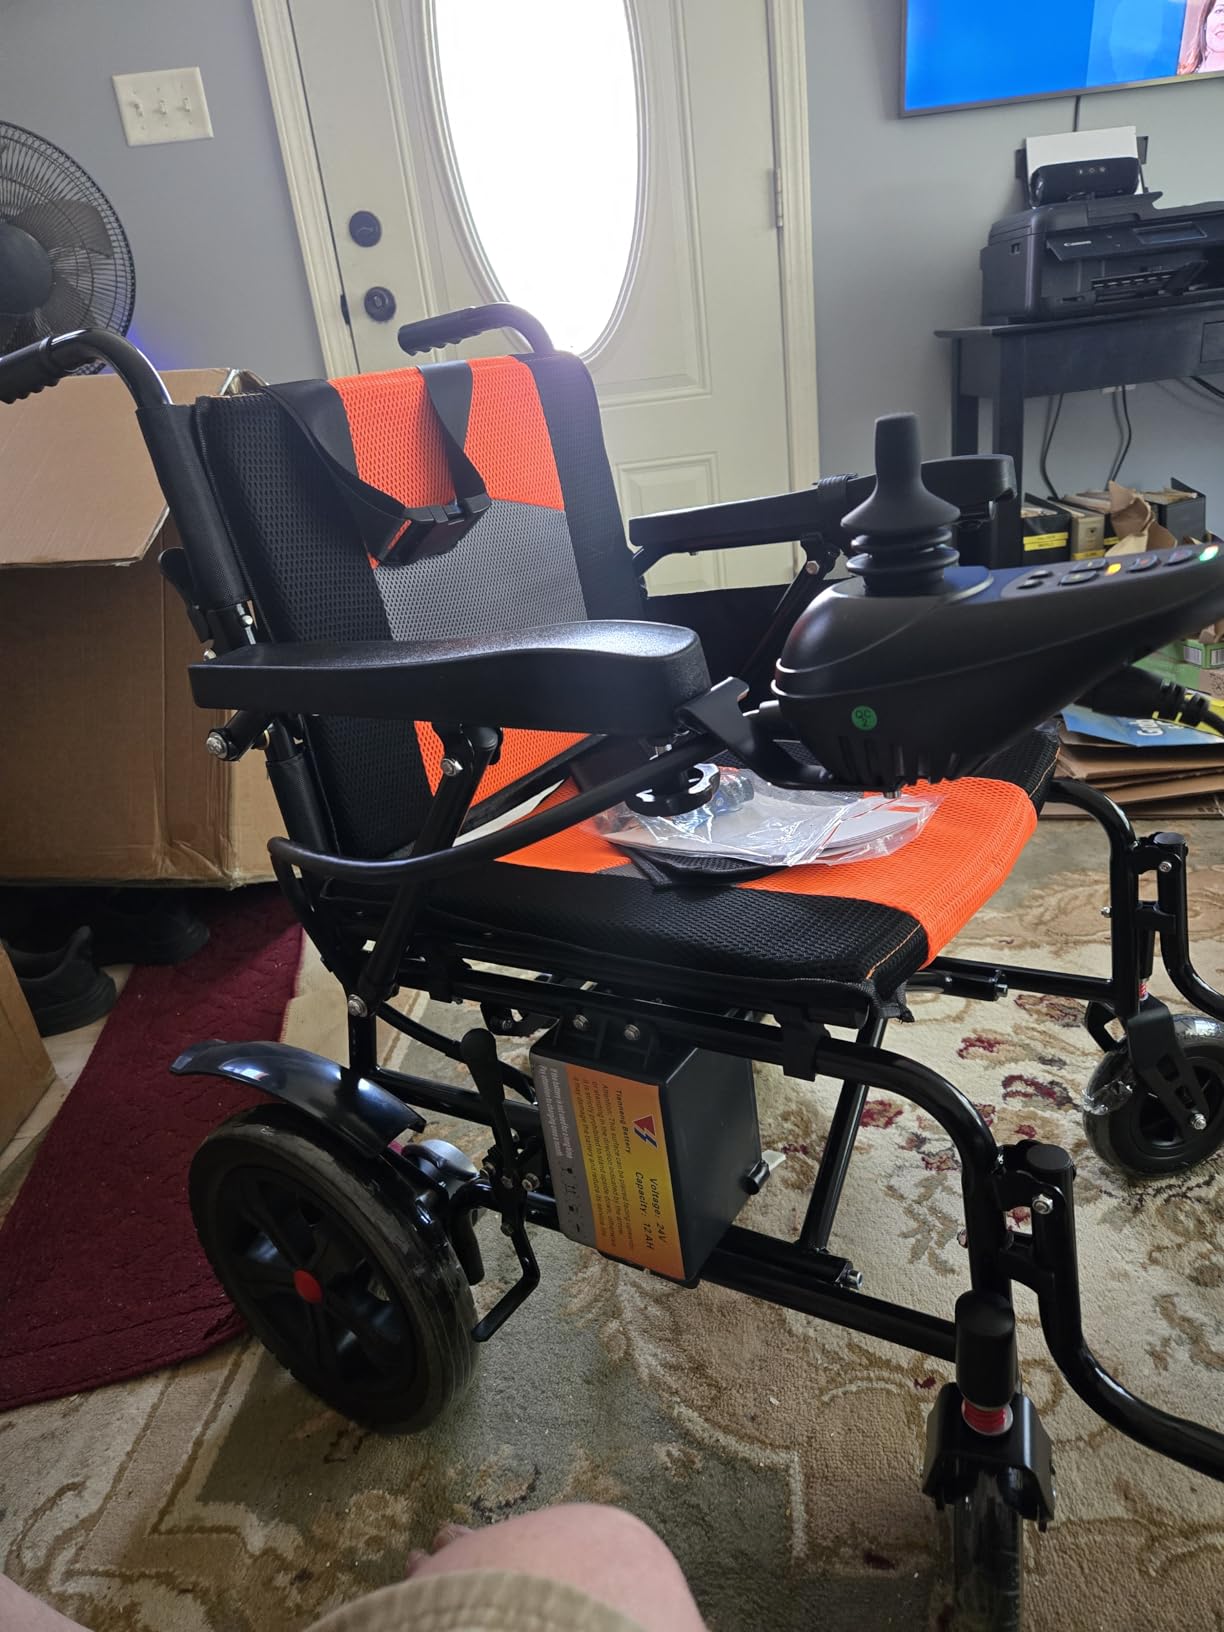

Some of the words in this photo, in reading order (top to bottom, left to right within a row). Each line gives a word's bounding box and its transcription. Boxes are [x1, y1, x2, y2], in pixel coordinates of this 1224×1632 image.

[621, 1125, 632, 1153] Battery
[633, 1170, 649, 1217] Capacity:
[647, 1176, 663, 1219] Voltage:
[656, 1222, 667, 1243] 24V
